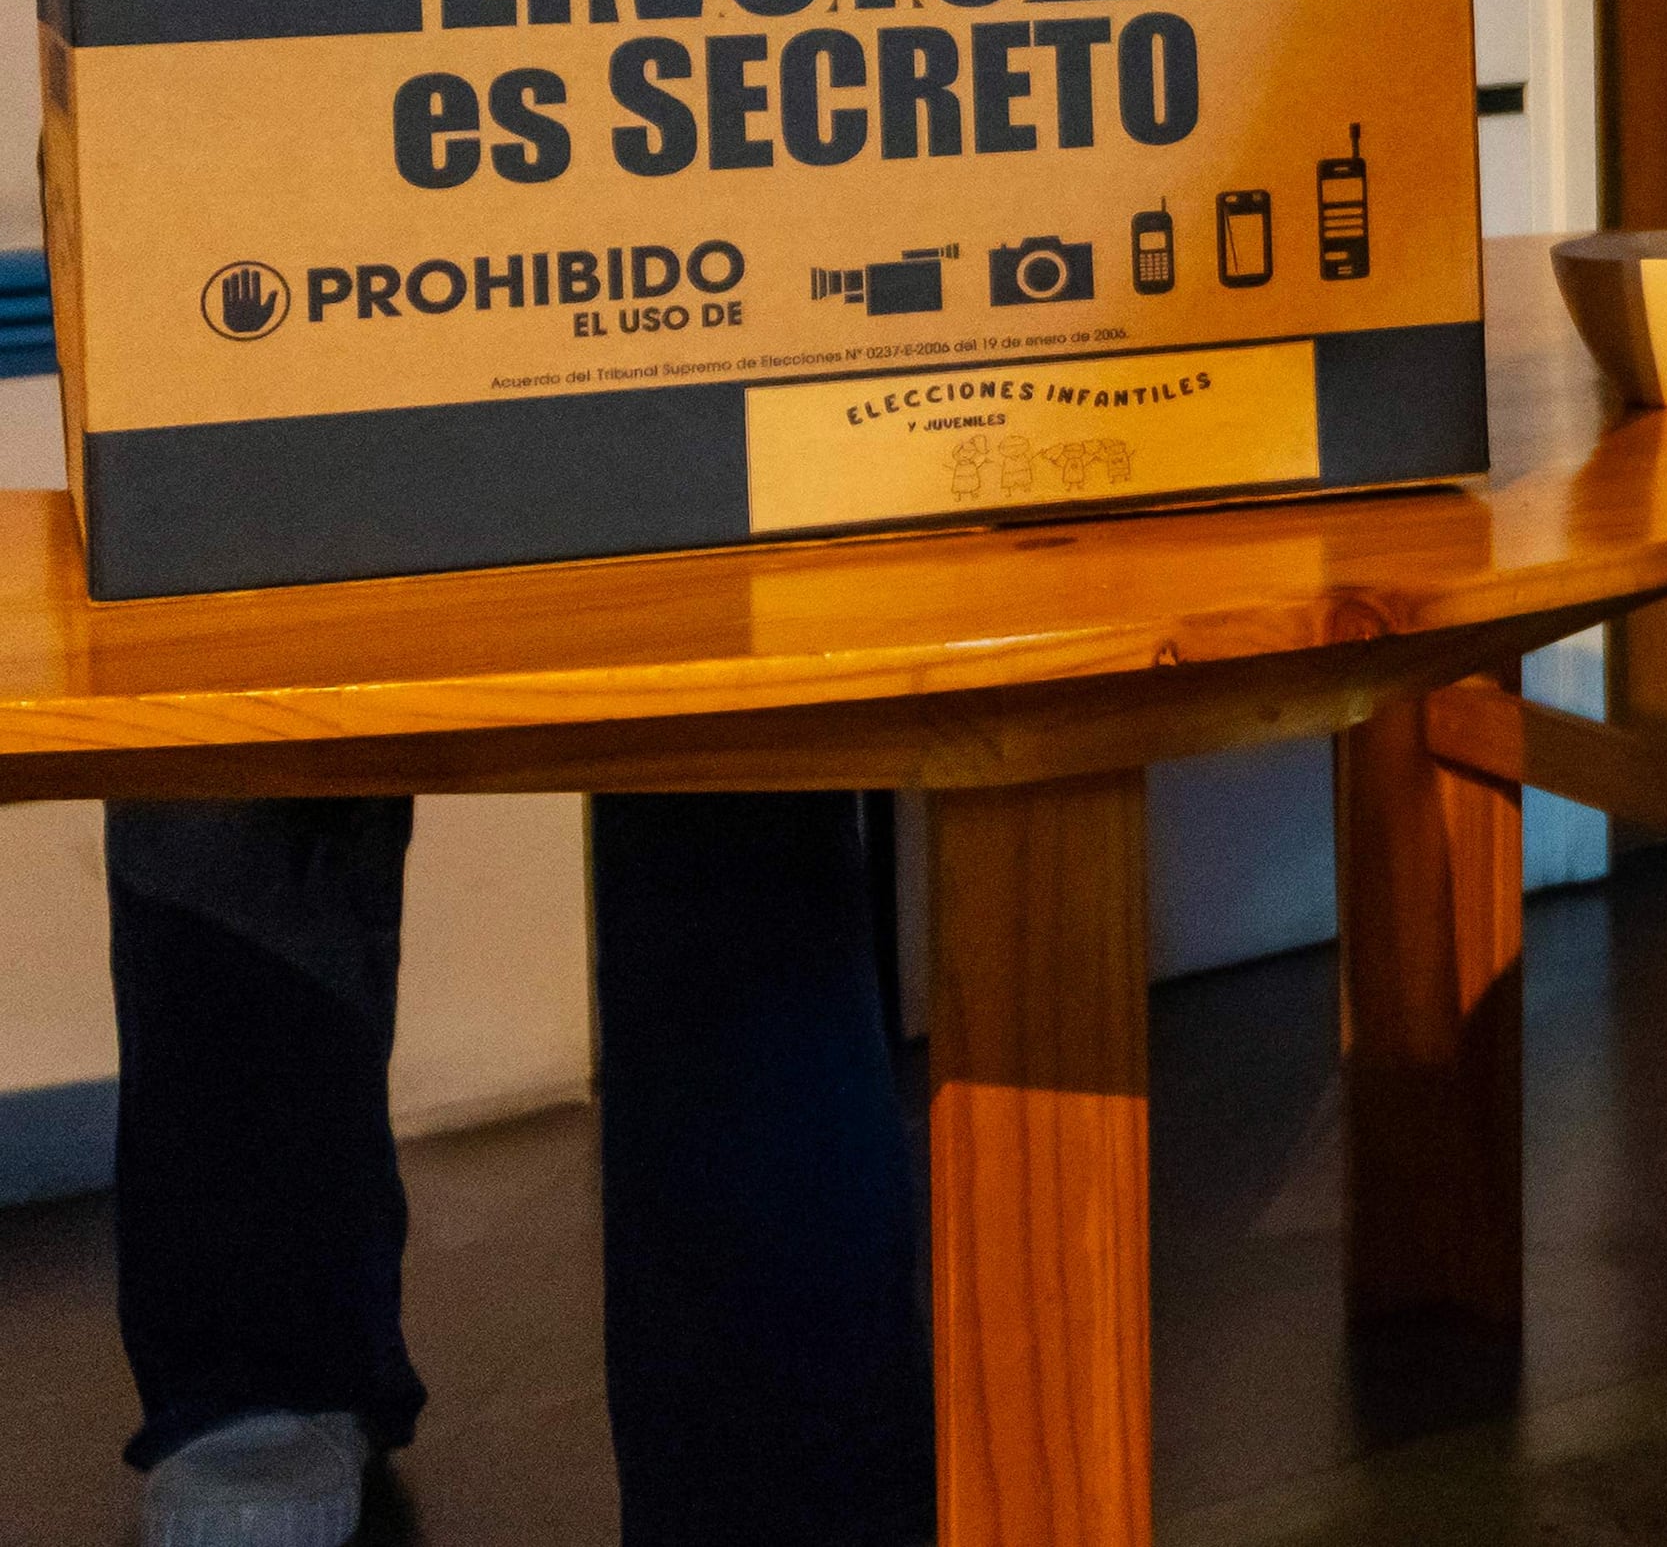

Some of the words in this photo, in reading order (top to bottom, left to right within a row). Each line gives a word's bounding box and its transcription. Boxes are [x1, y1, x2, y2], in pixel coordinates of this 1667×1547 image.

[394, 68, 571, 189] es
[609, 11, 1199, 177] SECRETO
[308, 239, 745, 321] PROHIBIDO
[573, 311, 607, 338] EL
[620, 305, 690, 335] USO
[702, 300, 743, 328] DE
[491, 373, 560, 389] Acuerdo
[565, 369, 590, 384] del
[597, 365, 658, 380] Tribunal
[663, 360, 731, 376] Supremo
[736, 357, 757, 370] de
[761, 351, 842, 368] Elecciones
[954, 337, 977, 351] del
[983, 338, 998, 350] 19
[1000, 335, 1021, 349] de
[1025, 333, 1067, 346] enero
[1070, 330, 1090, 343] de
[847, 380, 1034, 426] ELECCIONES
[1047, 372, 1211, 407] INFANTILES
[924, 413, 1006, 431] JUVENILES
